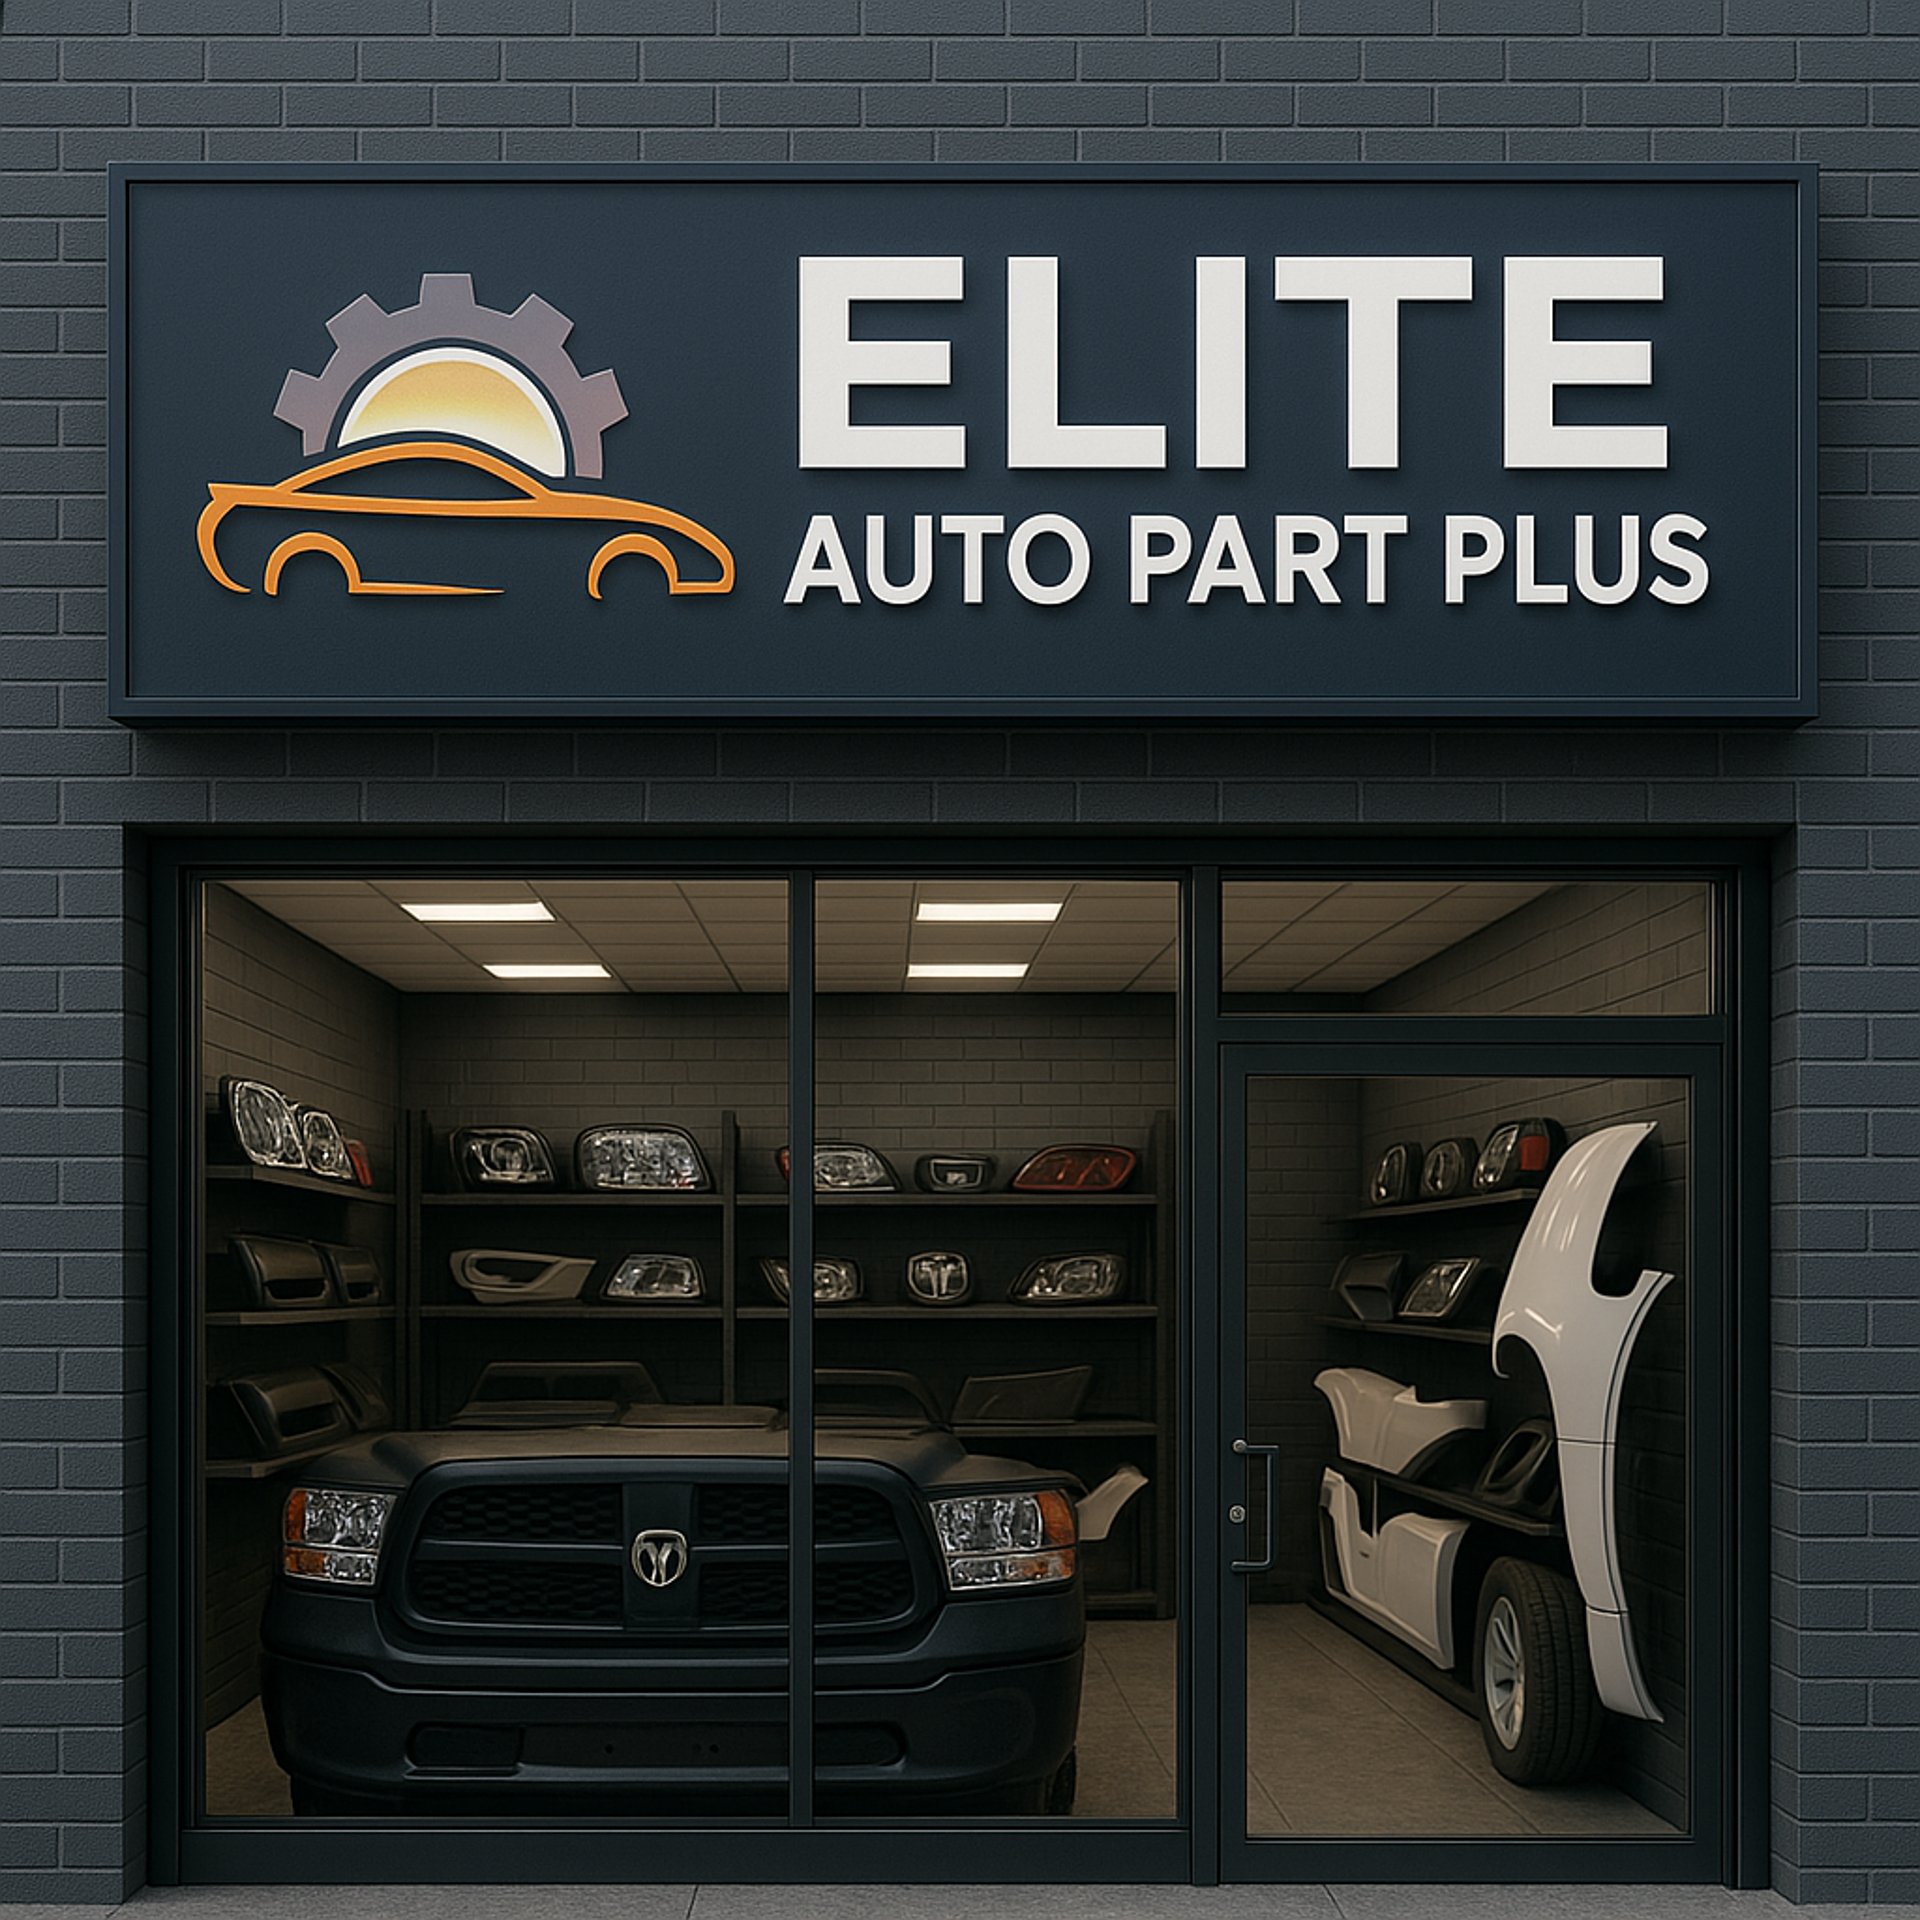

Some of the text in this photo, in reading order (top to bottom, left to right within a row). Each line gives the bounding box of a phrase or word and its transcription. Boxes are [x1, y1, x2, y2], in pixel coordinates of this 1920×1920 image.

[798, 256, 1670, 470] ELITE
[783, 513, 1710, 606] AUTO PART PLUS
